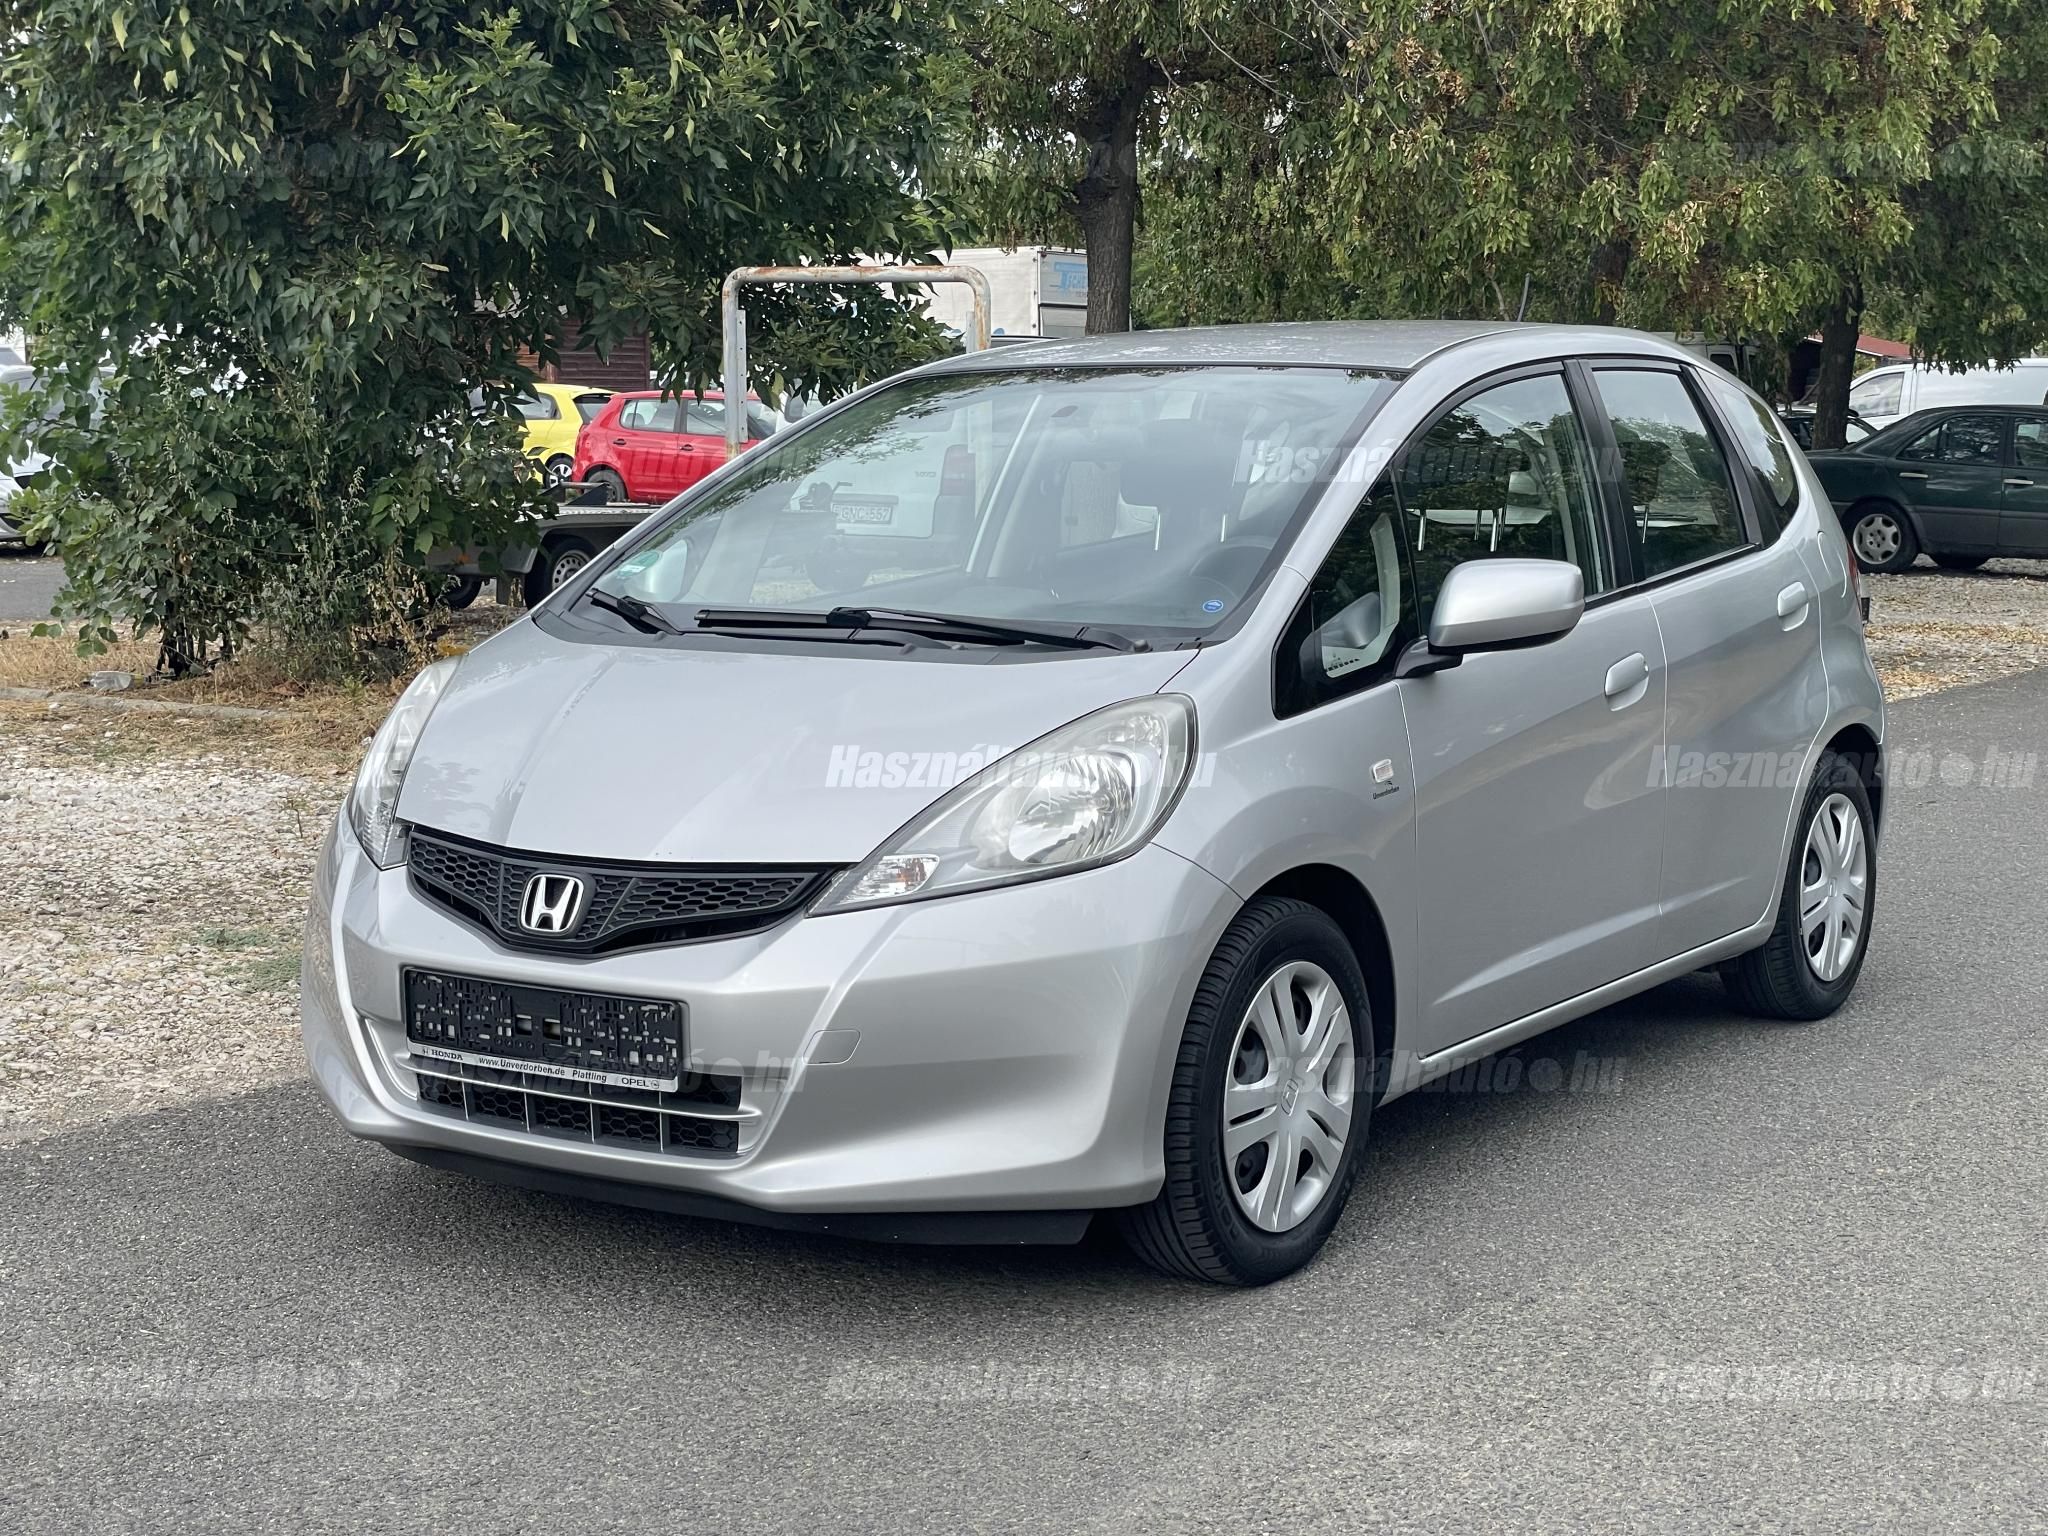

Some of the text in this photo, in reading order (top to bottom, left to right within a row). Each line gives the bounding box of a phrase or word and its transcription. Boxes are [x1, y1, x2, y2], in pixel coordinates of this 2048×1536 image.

[431, 1049, 463, 1061] HONDA
[479, 1057, 566, 1076] www.Unverdorben.de
[621, 1077, 650, 1088] OPEL
